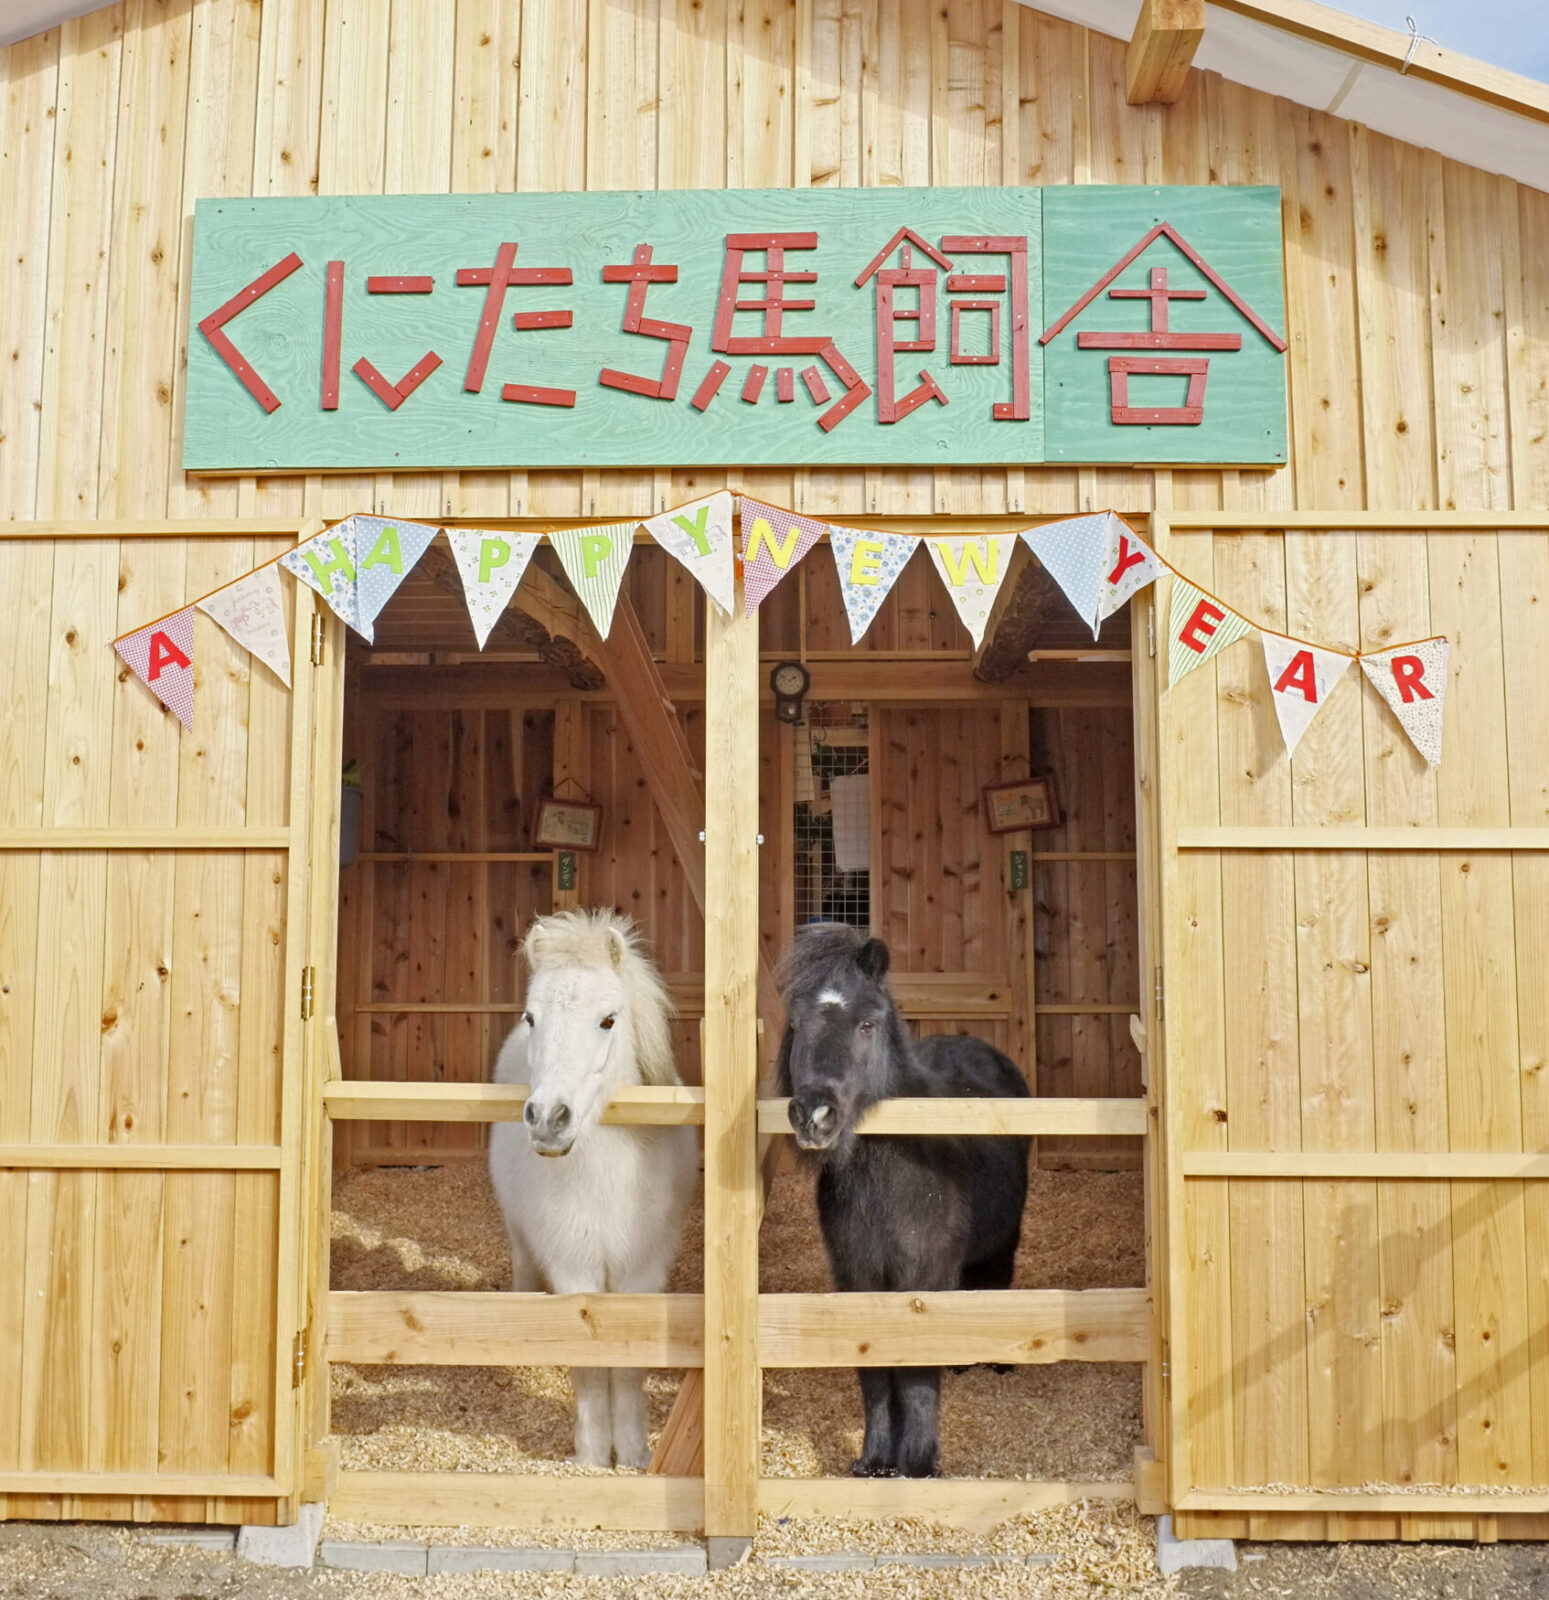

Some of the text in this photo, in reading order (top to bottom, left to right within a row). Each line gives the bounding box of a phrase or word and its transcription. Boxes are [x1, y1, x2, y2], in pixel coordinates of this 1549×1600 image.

[197, 221, 1288, 434] くにたち馬飼舎
[147, 505, 1435, 704] A HAPPY NEW YEAR
